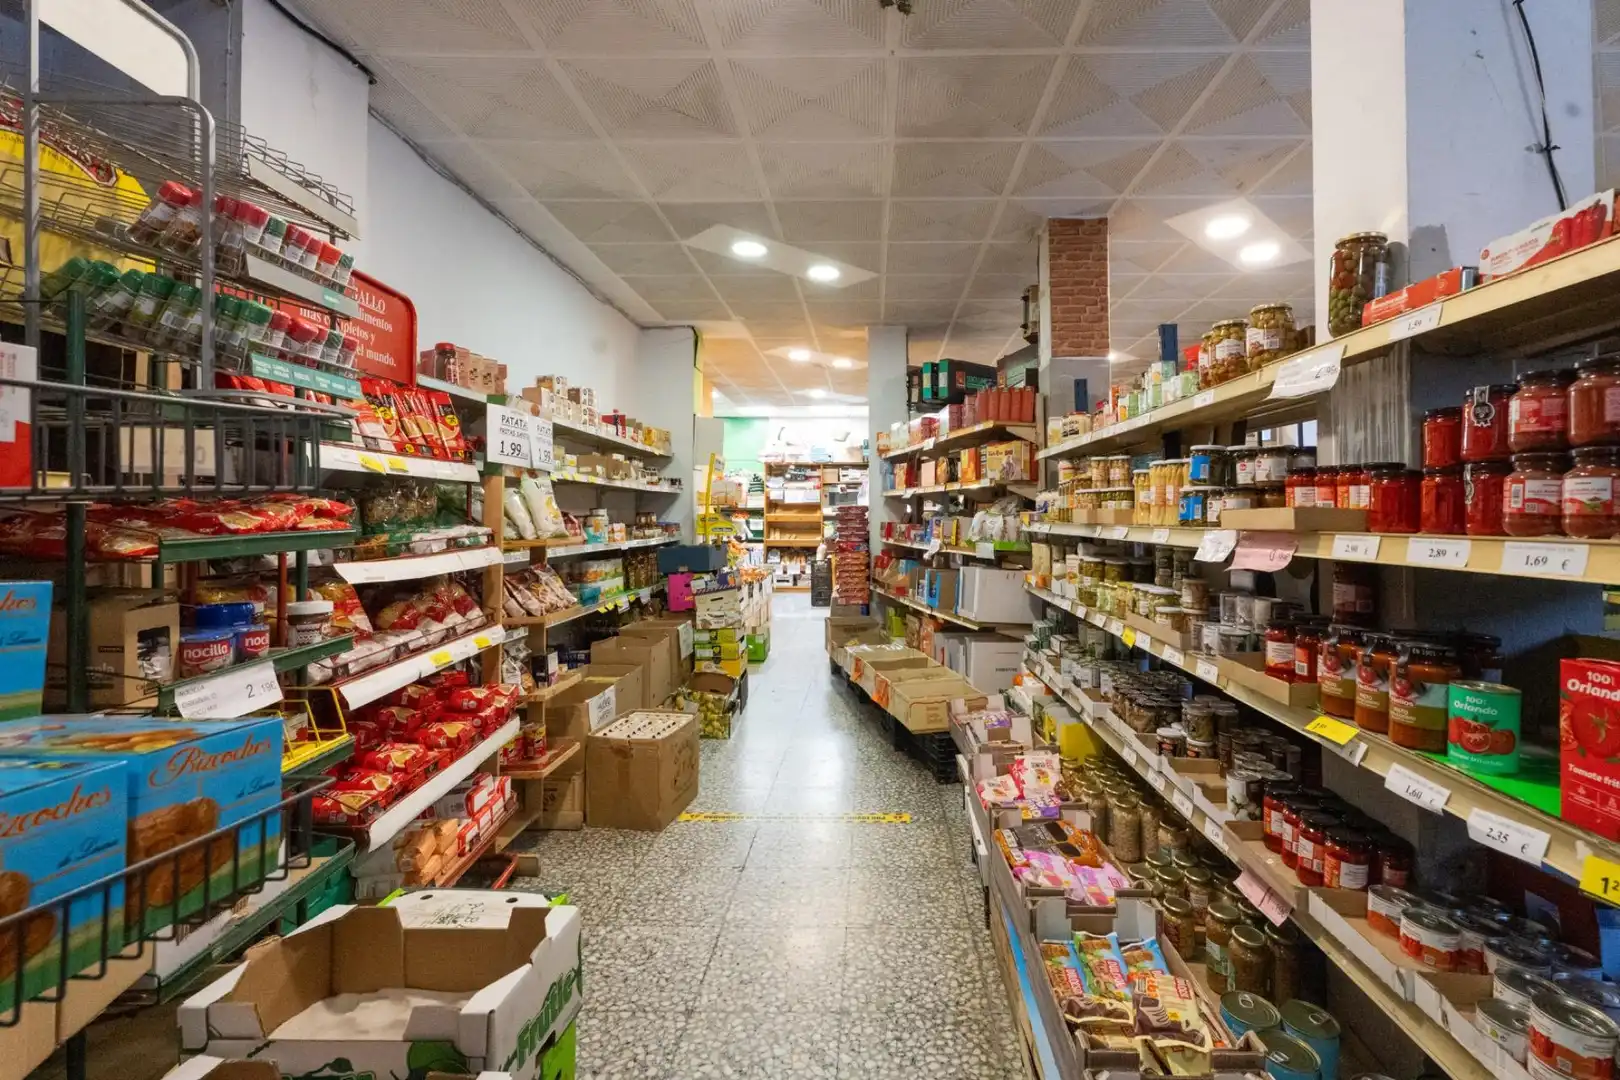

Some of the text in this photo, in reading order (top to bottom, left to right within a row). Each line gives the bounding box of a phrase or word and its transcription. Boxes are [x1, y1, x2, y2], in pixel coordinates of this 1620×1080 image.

[359, 307, 393, 332] limentos
[500, 440, 522, 457] 1,99
[1561, 558, 1570, 571] €
[183, 643, 230, 659] nocilla
[1454, 699, 1499, 716] Orlando
[1485, 826, 1530, 854] 2,35 €
